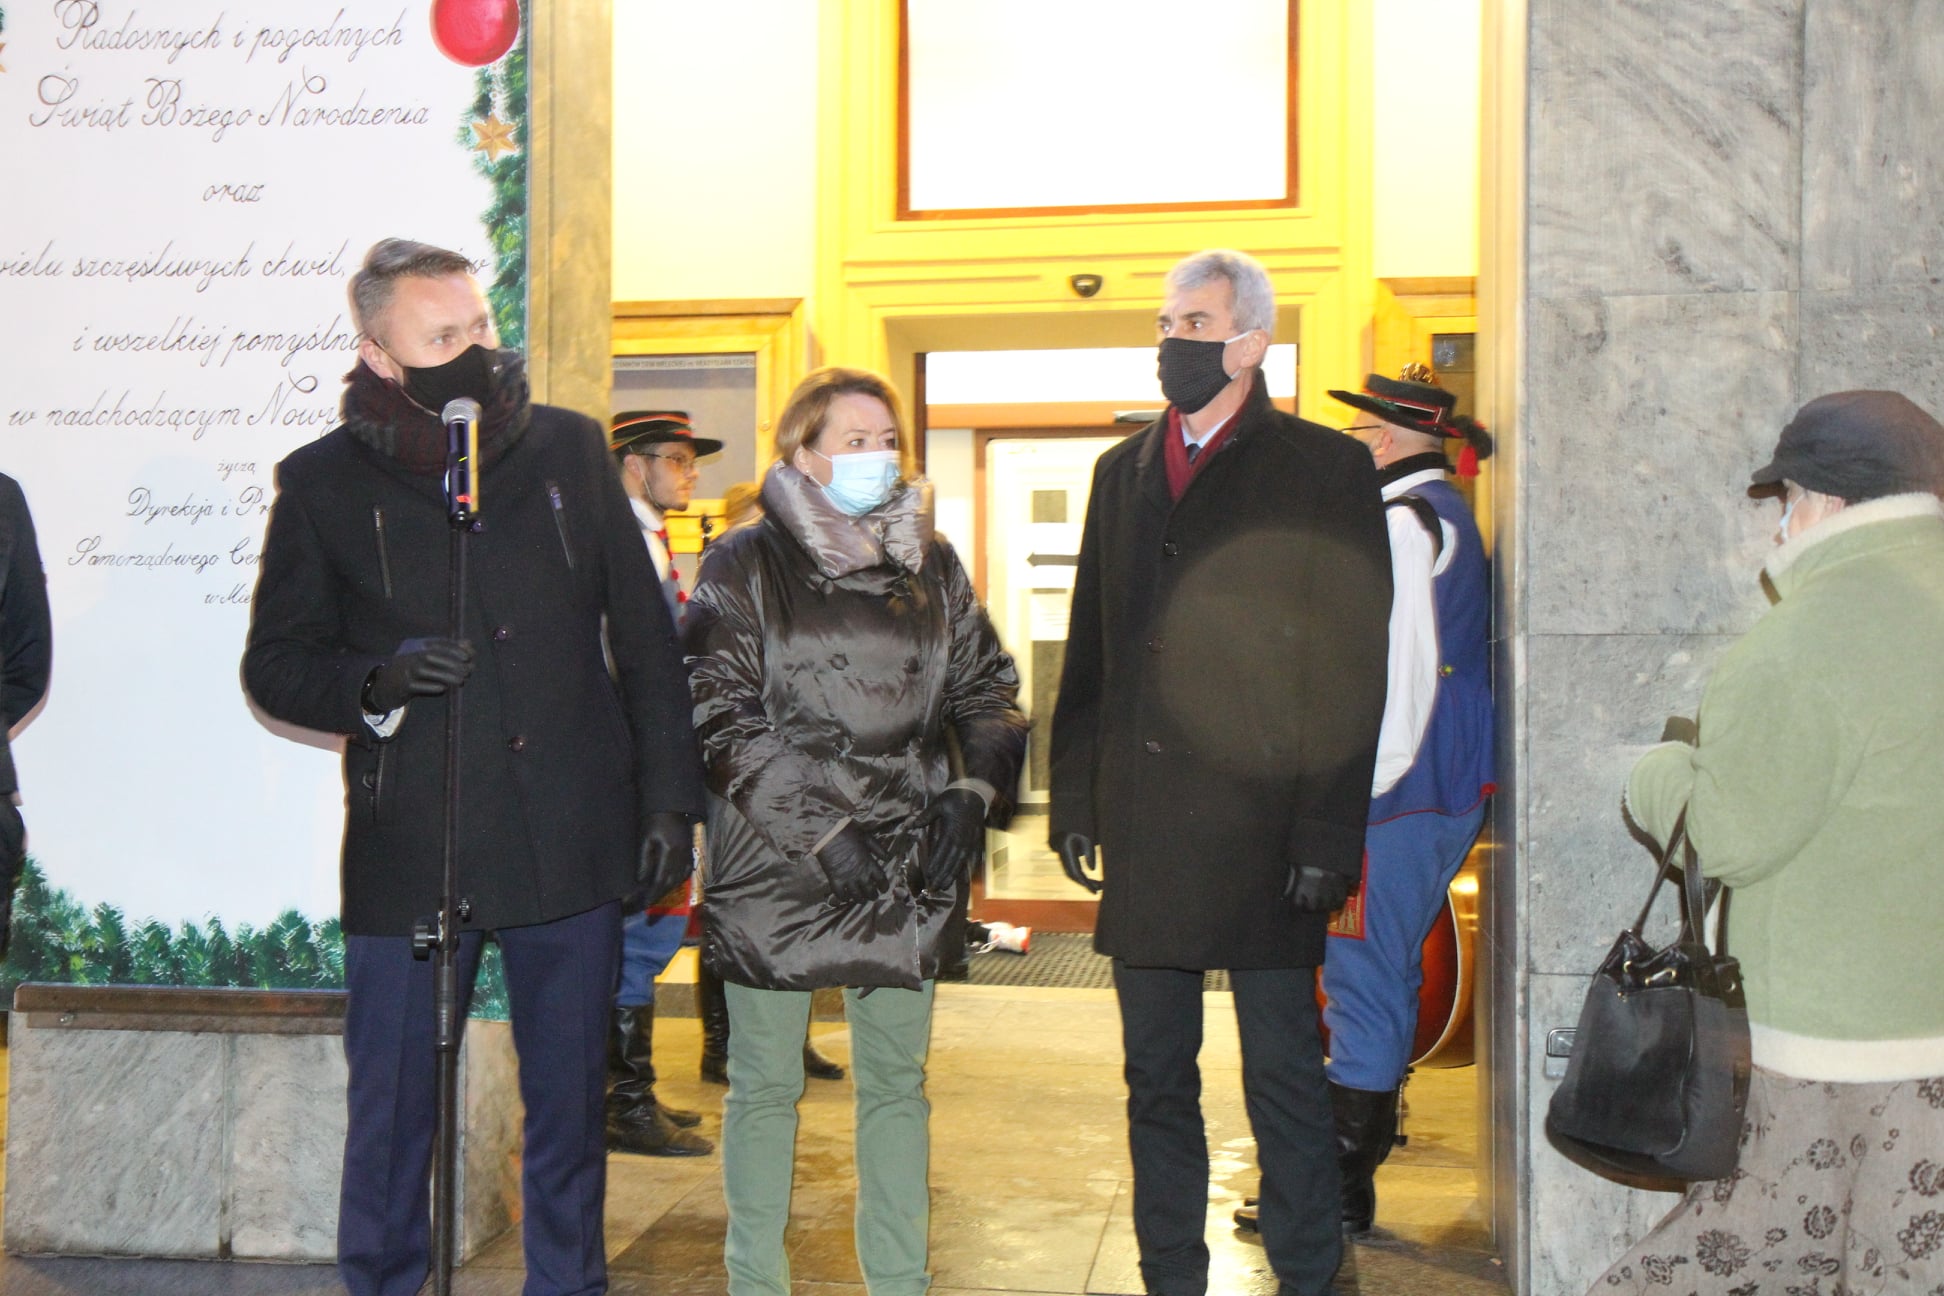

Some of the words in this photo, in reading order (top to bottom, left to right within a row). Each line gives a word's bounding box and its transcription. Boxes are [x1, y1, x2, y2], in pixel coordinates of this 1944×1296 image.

[55, 0, 224, 64] Radosnych
[233, 20, 250, 48] i
[246, 7, 406, 64] pogodnych
[29, 65, 133, 132] Świąt
[141, 77, 253, 143] Bożego
[258, 64, 430, 127] Narodzenia
[202, 183, 265, 202] oraz
[72, 239, 254, 293] szczęśliwych
[72, 325, 89, 351] i
[94, 315, 227, 368] wszelkiej
[8, 408, 37, 427] w
[46, 389, 241, 441] nadchodzącym
[217, 459, 257, 481] życzą
[126, 486, 213, 525] Dyrekcja
[221, 498, 232, 517] i
[67, 535, 220, 574] Samorządowego
